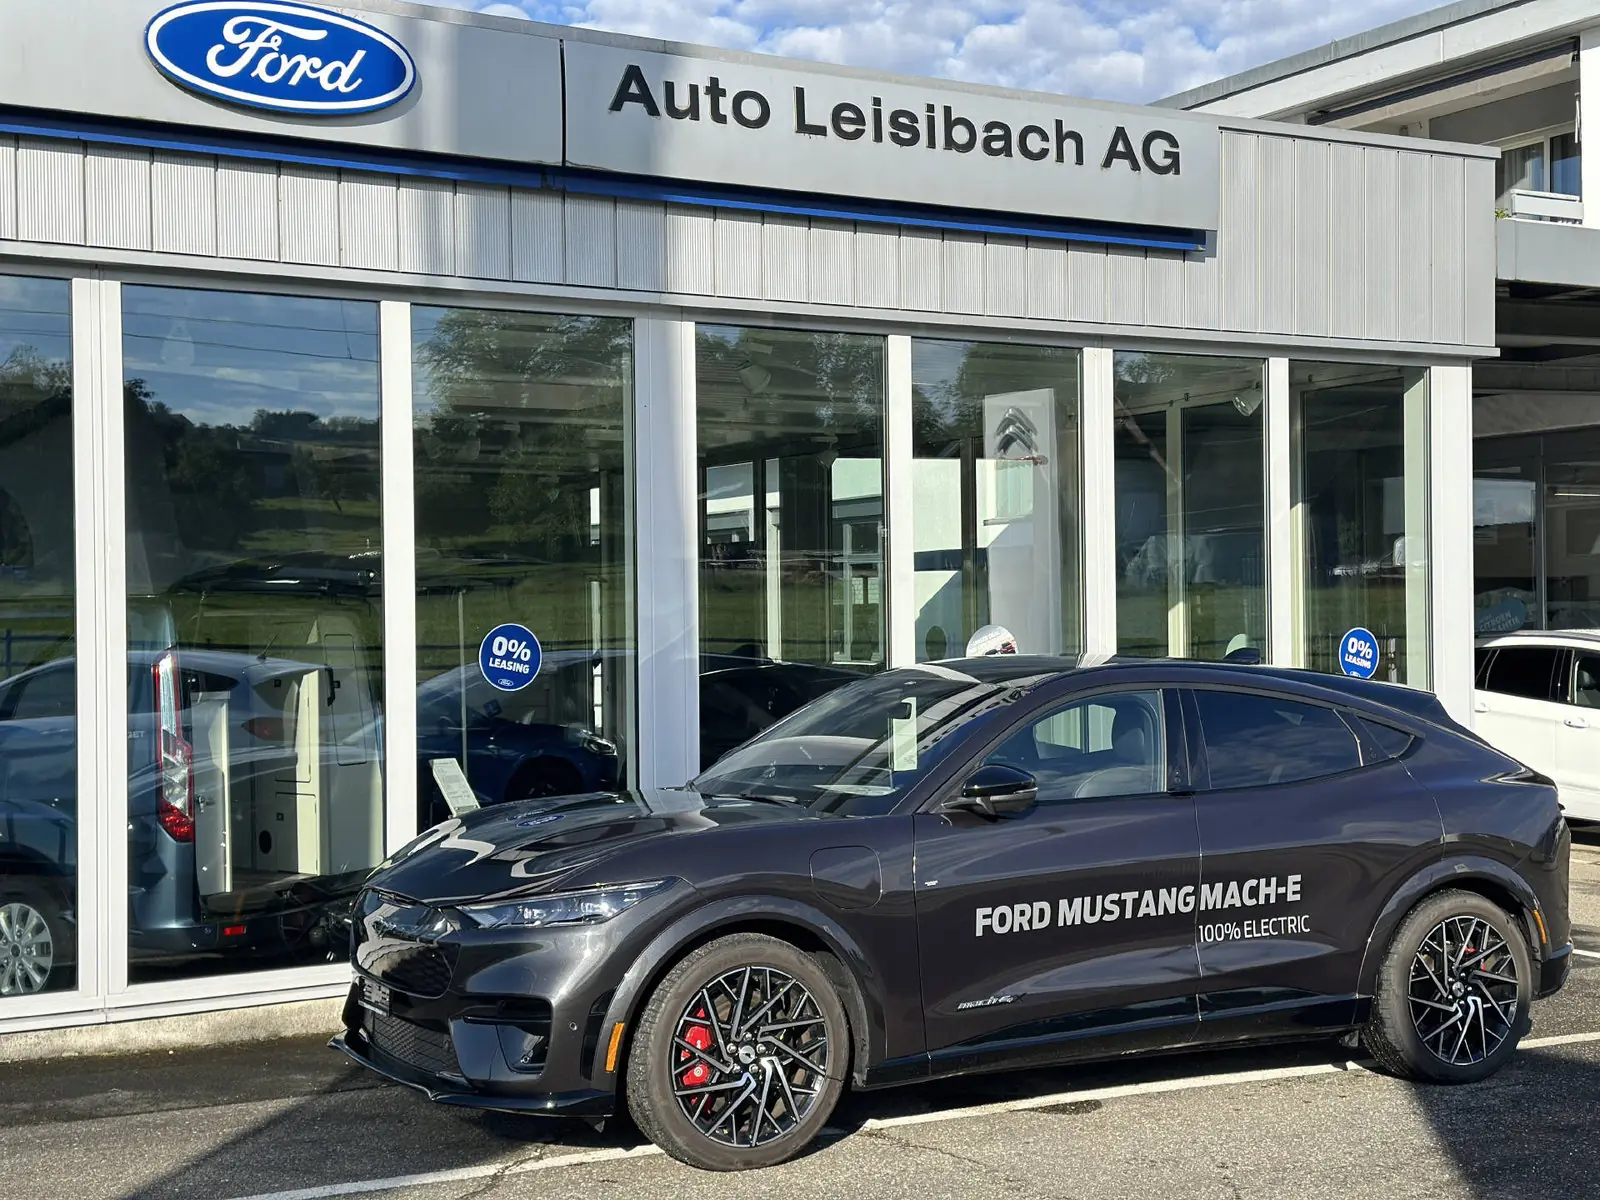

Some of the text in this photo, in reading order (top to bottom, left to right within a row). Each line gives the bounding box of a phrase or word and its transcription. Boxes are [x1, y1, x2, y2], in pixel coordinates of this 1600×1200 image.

[206, 15, 367, 93] Ford
[608, 64, 1181, 175] Auto Leisibach AG
[492, 636, 531, 661] 0%
[1344, 653, 1372, 669] LEASING
[1347, 637, 1373, 659] 0%
[488, 657, 530, 674] LEASING
[975, 874, 1302, 937] FORD MUSTANG MACH-E
[1198, 915, 1311, 943] 100% ELECTRIC
